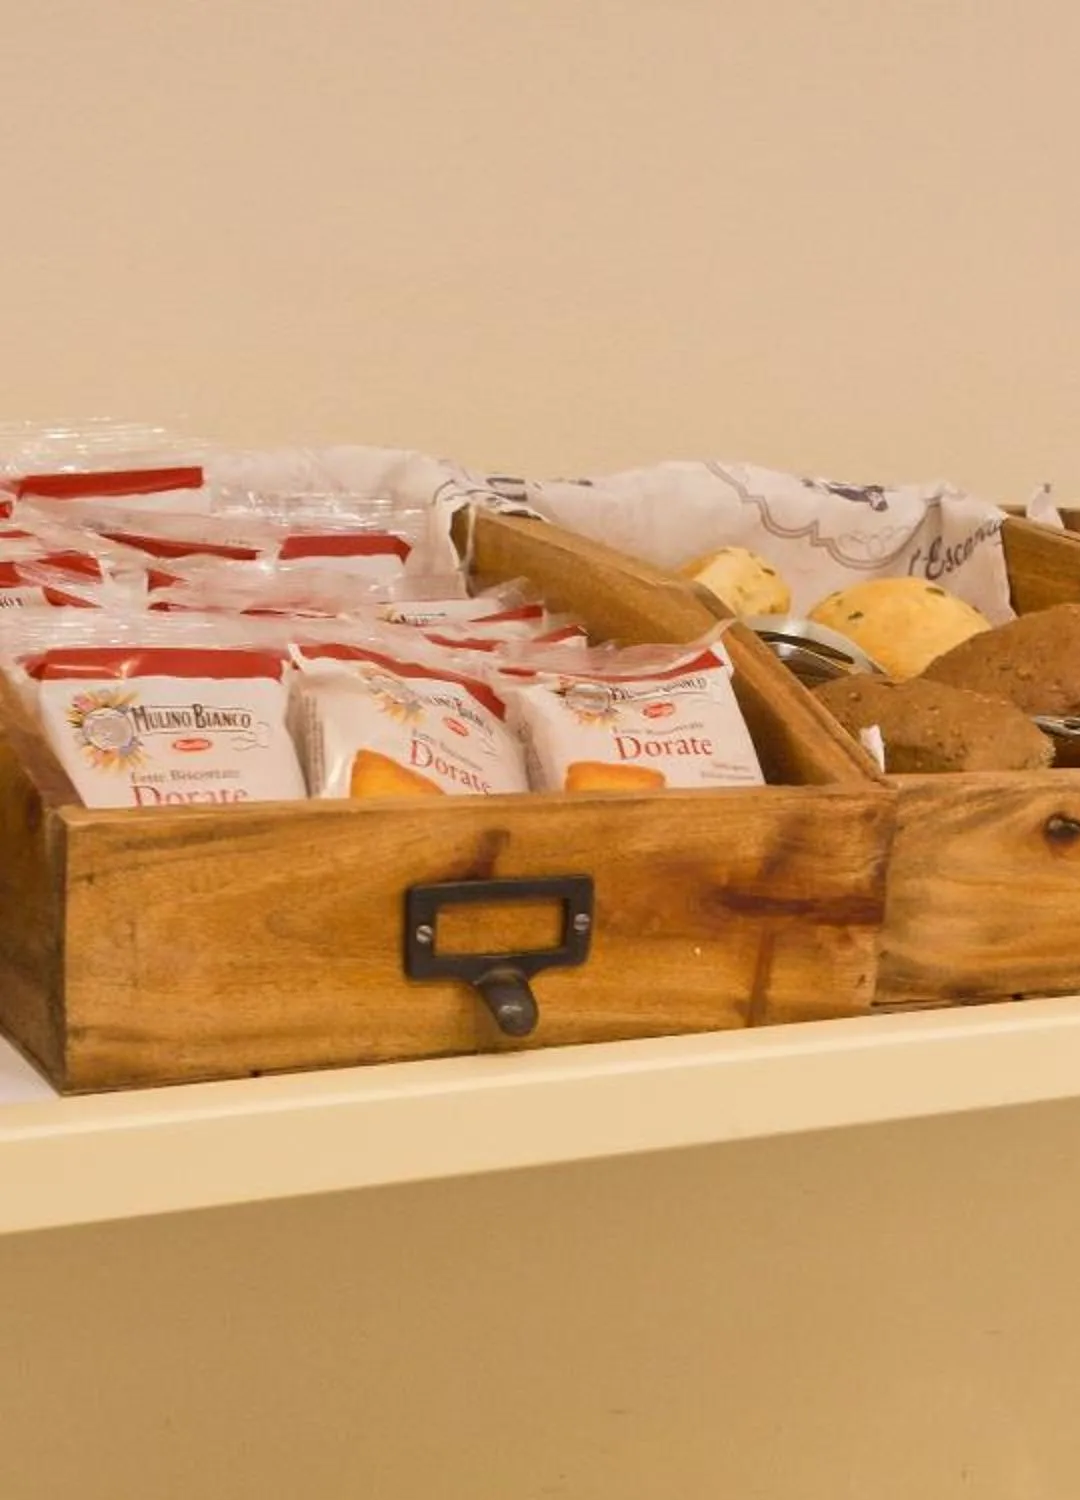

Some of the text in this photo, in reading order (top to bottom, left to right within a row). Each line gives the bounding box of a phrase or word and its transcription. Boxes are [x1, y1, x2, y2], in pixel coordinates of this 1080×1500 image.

[131, 703, 252, 732] MULINO BIANCO
[614, 734, 713, 761] Dorate
[409, 739, 493, 796] Dorate
